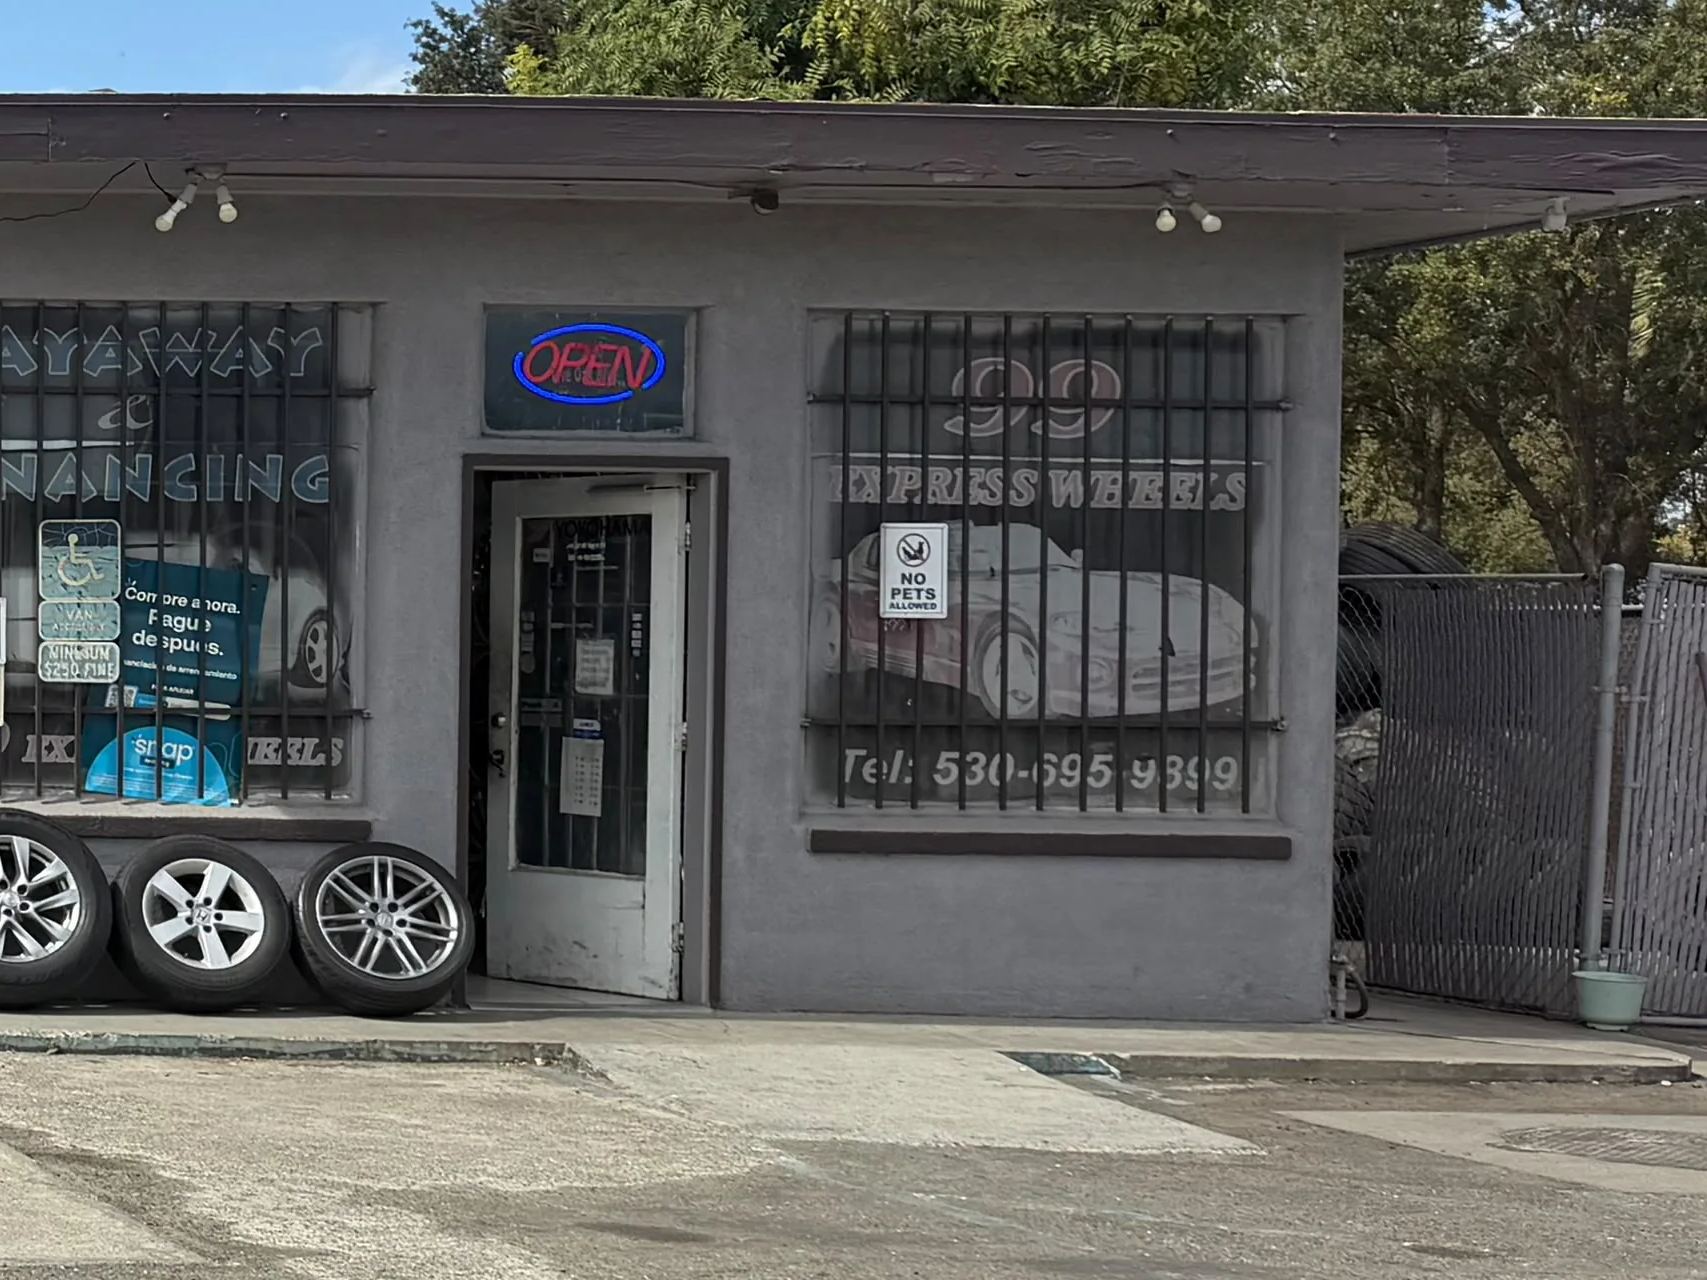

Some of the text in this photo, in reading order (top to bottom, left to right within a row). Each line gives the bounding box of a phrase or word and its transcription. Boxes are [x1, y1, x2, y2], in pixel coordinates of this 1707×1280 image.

[523, 340, 652, 389] OPEN
[944, 357, 1122, 438] 99
[828, 465, 1247, 511] EXPRESS WHEELS
[901, 572, 926, 585] NO
[889, 602, 937, 610] ALLOWED
[891, 587, 936, 600] PETS
[66, 610, 93, 620] VAN
[933, 751, 1239, 790] 530-6959899
